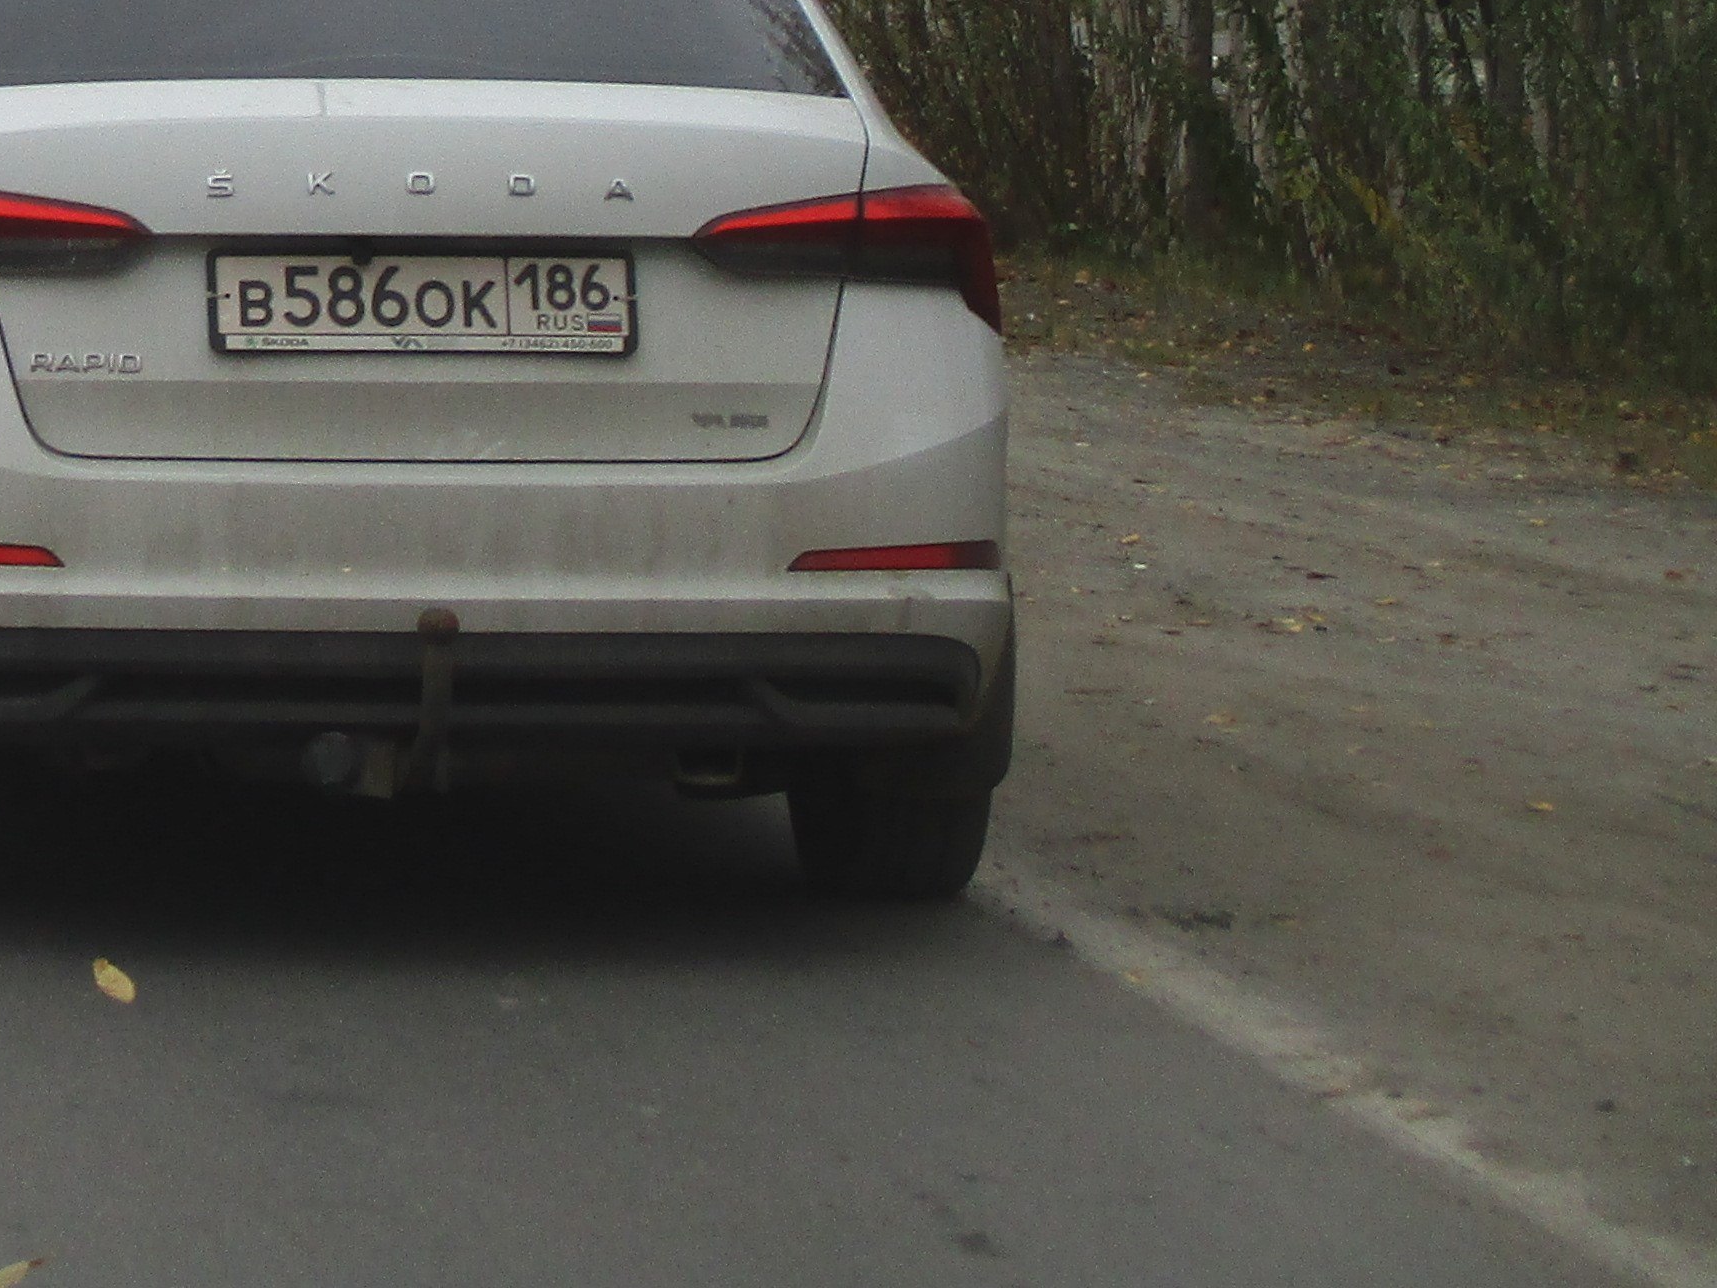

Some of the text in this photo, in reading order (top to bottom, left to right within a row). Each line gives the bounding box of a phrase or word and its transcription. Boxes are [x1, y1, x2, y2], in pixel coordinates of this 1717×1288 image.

[238, 263, 611, 329] В586ОК 186
[536, 313, 585, 331] RUS
[30, 353, 142, 373] RAPID
